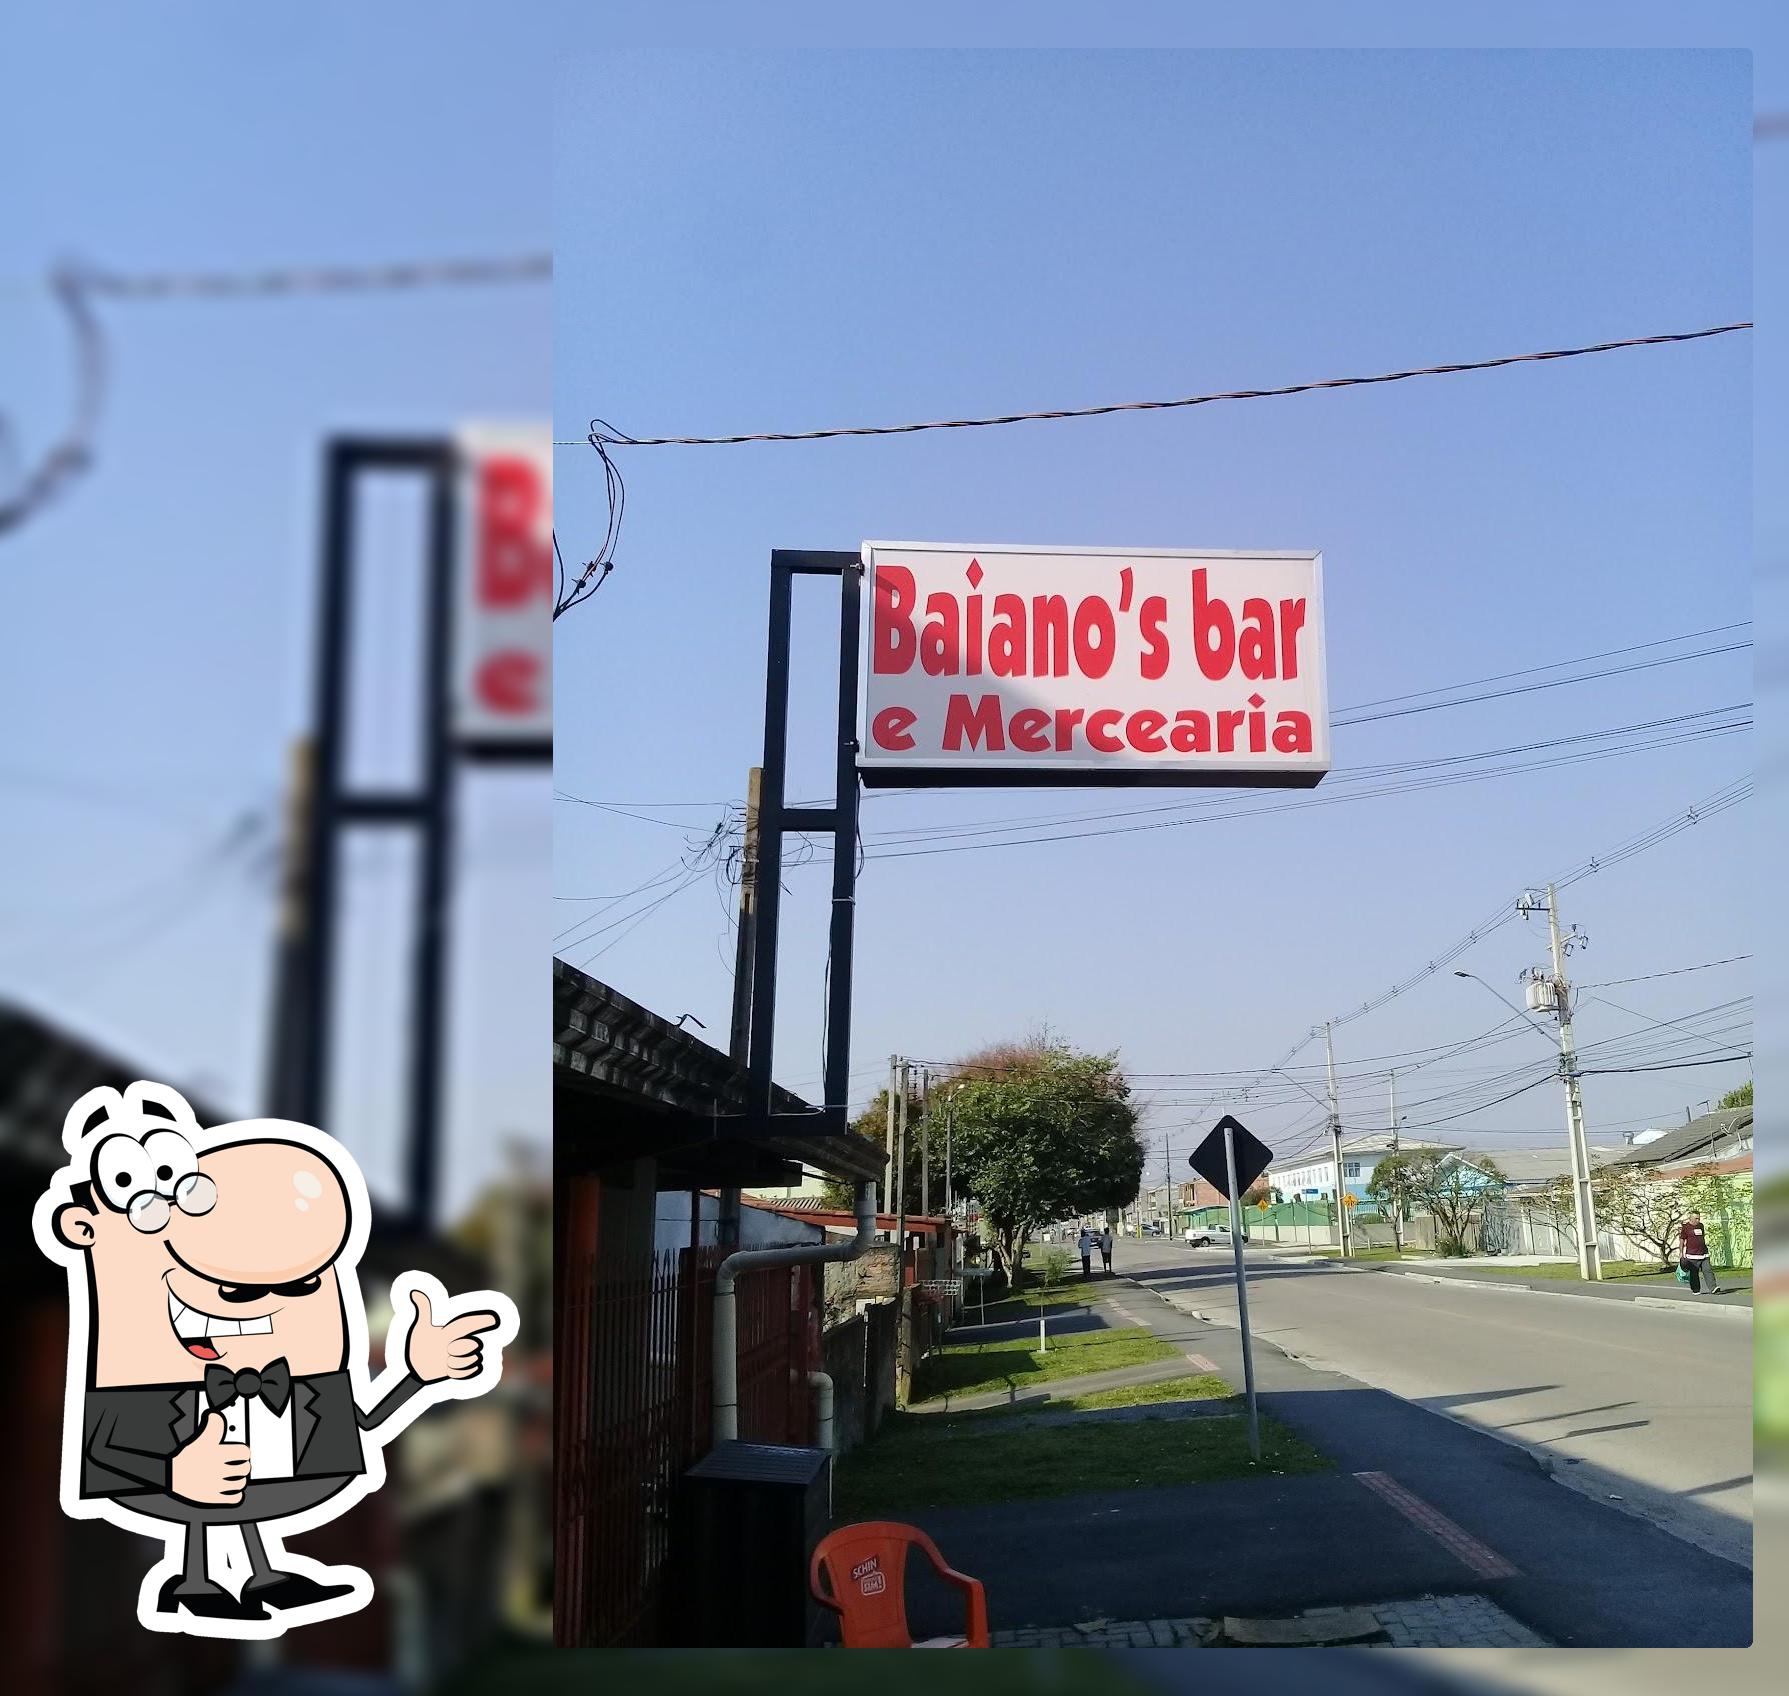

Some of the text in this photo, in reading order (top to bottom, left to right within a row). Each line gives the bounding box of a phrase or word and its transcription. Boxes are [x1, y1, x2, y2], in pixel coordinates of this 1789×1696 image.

[873, 558, 1307, 682] Baiano's bar
[872, 693, 1314, 754] e Mercearia
[853, 1557, 877, 1579] SCHIN
